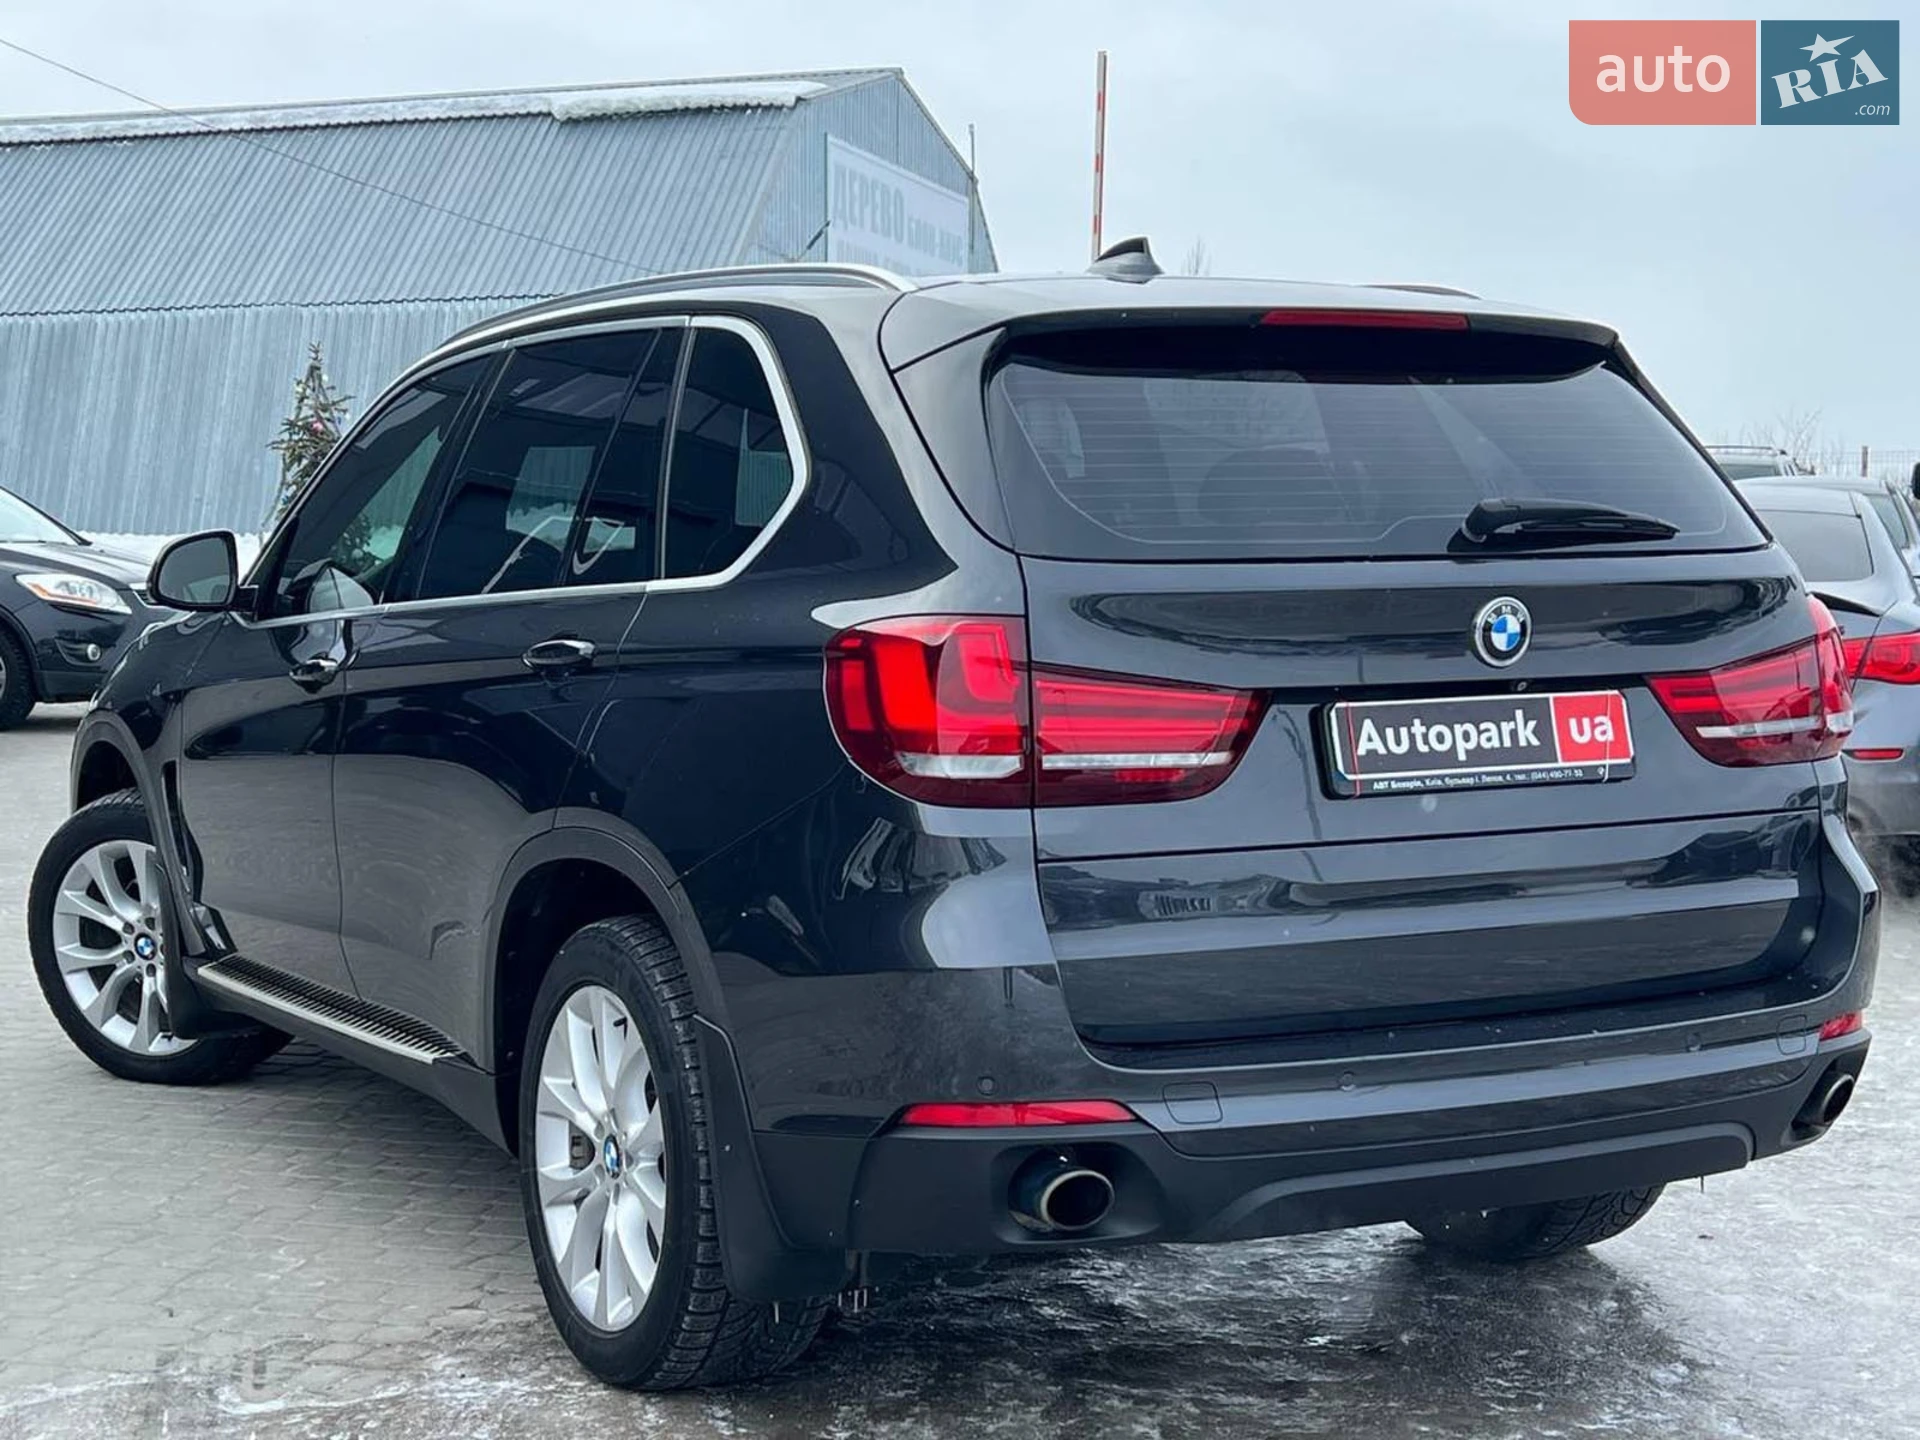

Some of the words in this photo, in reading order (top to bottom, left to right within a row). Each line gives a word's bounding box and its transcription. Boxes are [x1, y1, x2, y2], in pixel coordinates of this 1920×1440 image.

[832, 163, 905, 245] ДЕРЕВО
[1486, 605, 1526, 625] BMW
[1356, 708, 1541, 762] Autopark
[1568, 714, 1614, 744] ua
